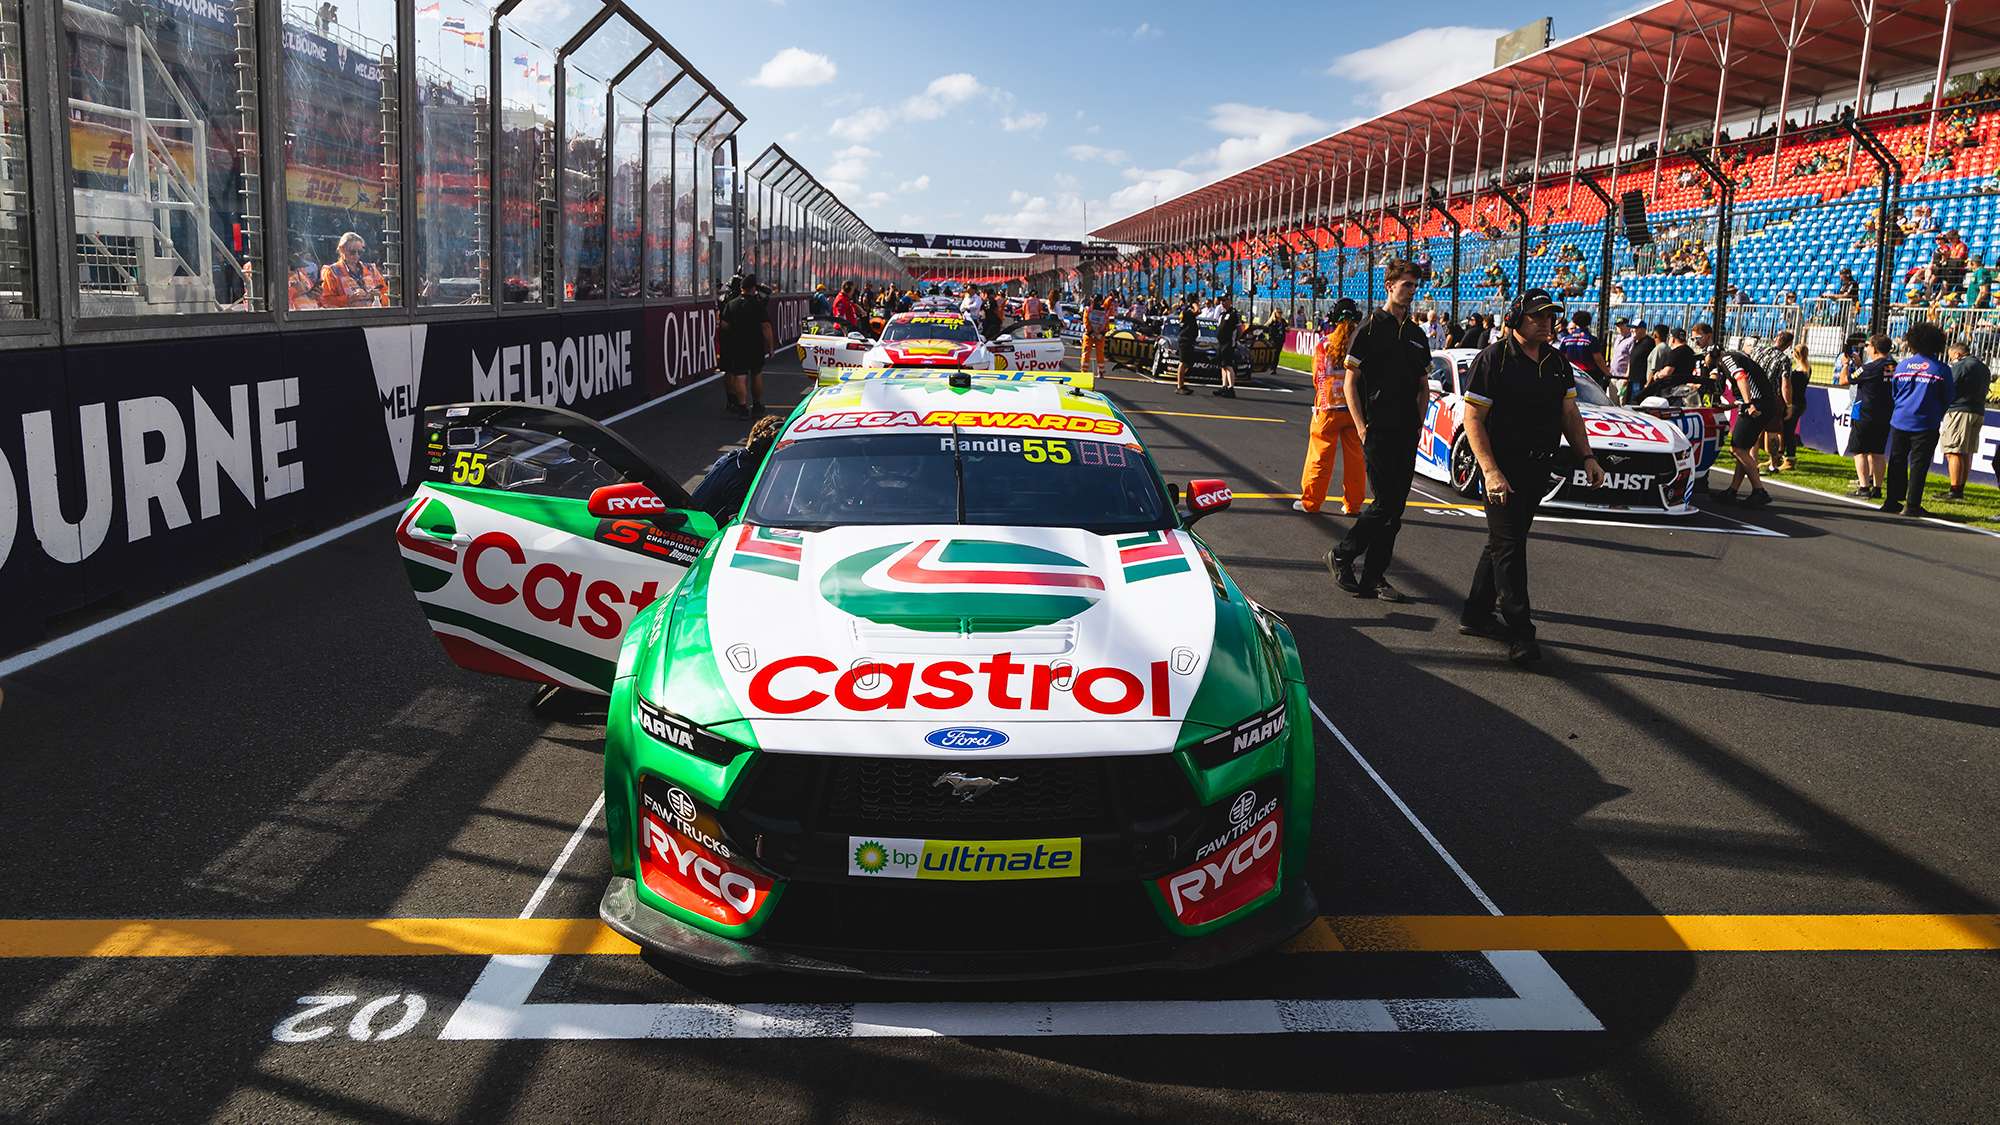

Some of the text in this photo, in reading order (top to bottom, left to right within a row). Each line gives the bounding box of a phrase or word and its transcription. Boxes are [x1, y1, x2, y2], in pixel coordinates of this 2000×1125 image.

[883, 236, 914, 245] Australia
[946, 239, 1006, 249] MELBOURNE
[1040, 243, 1072, 252] Australia
[811, 325, 819, 335] 17
[911, 317, 965, 326] PIRTEK
[664, 309, 717, 386] QATAR
[814, 346, 835, 356] Shell
[1014, 350, 1036, 360] Shell
[472, 330, 632, 407] MELBOURNE
[379, 384, 418, 421] MEL
[796, 411, 1123, 435] MEGA REWARDS
[1586, 419, 1657, 441] OLY
[1834, 413, 1851, 428] ME
[940, 437, 1071, 465] Randle 55
[0, 376, 305, 573] URNE
[452, 451, 487, 486] 55
[1573, 469, 1656, 490] BAHST
[607, 496, 665, 511] RYCO
[1195, 487, 1233, 507] RYCO
[646, 534, 701, 554] CHAMPIONSH
[648, 527, 705, 547] SUPERCAR
[463, 531, 659, 640] Cast
[748, 651, 1171, 717] Castrol
[941, 729, 991, 747] Ford
[644, 794, 731, 858] FAW TRUCKS
[1195, 798, 1278, 861] FAW TRUCKS
[643, 816, 756, 914] RYCO
[893, 844, 1073, 872] bp ultimate
[1169, 820, 1278, 917] RYCO
